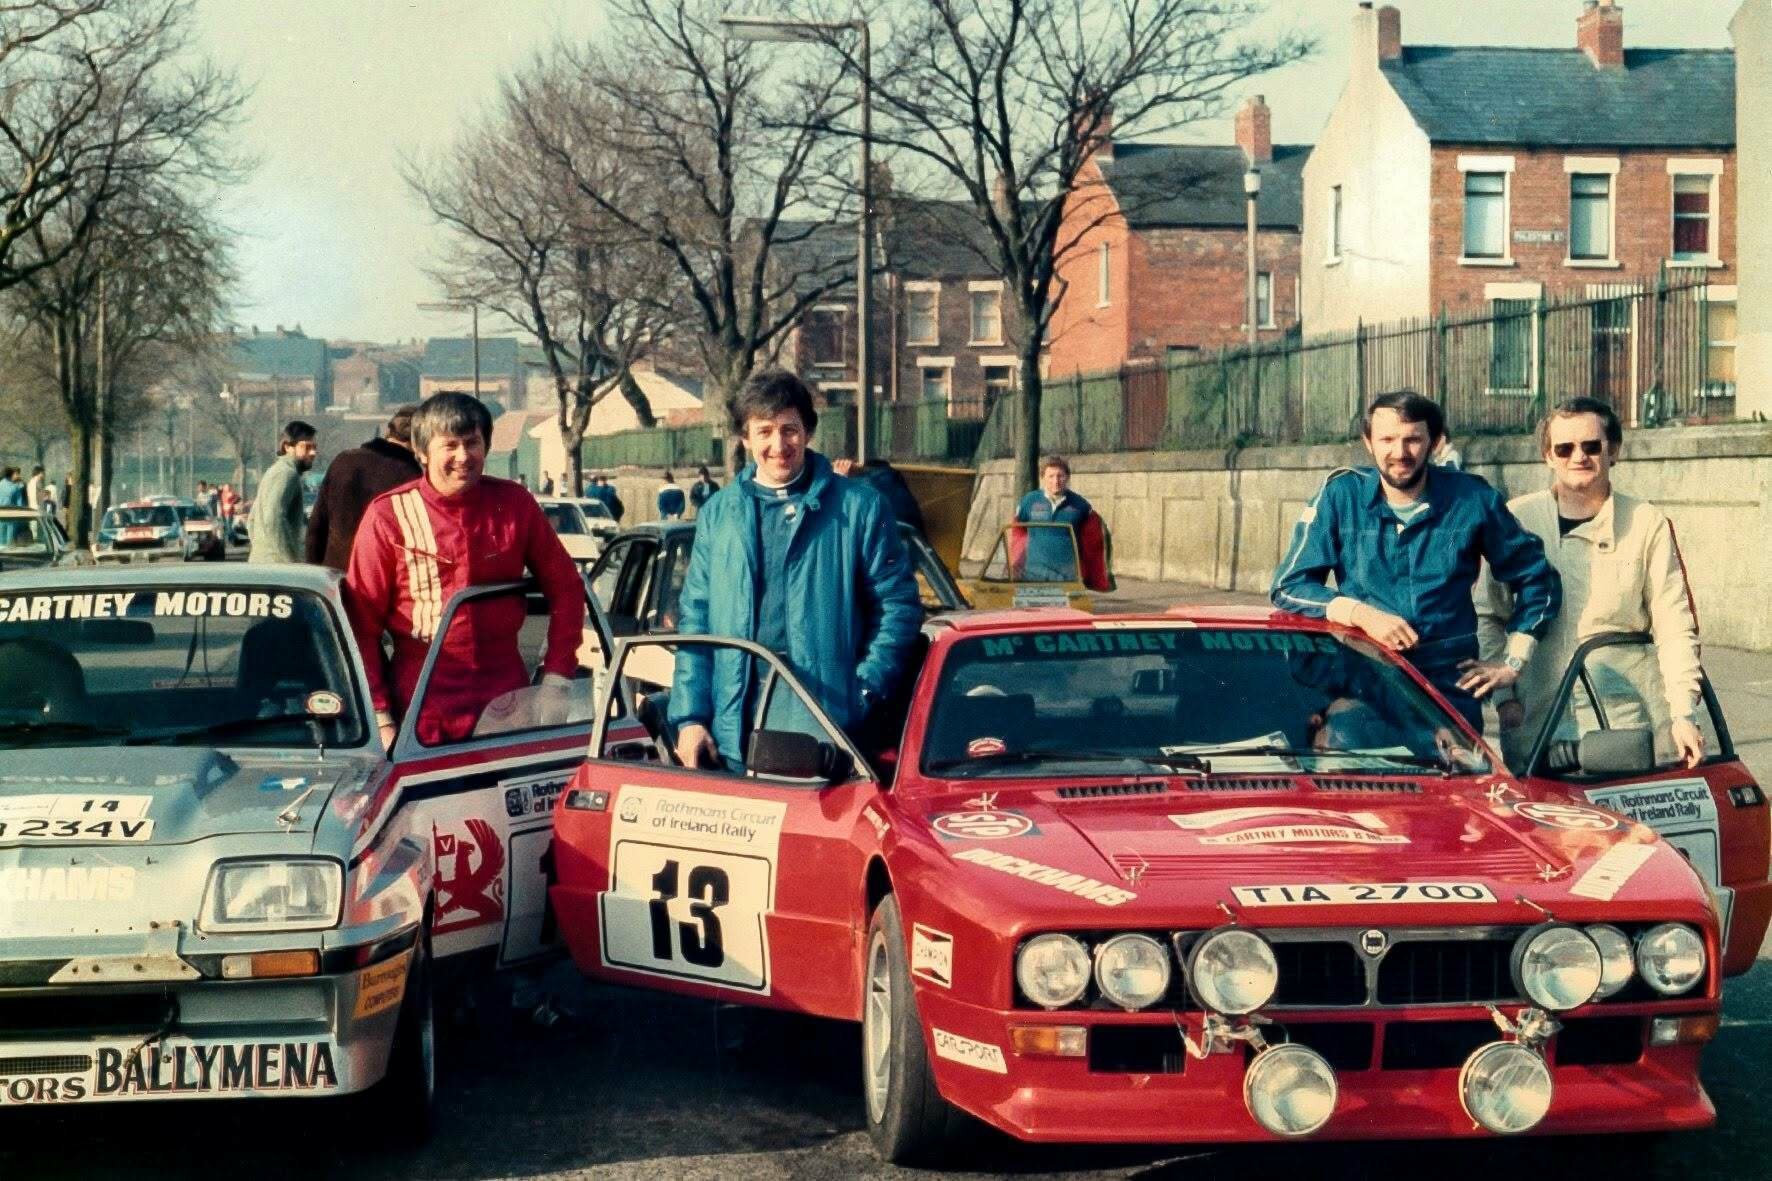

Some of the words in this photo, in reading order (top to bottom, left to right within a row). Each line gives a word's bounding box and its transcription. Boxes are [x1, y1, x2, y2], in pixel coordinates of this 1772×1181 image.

[154, 591, 293, 619] MOTORS
[1035, 632, 1176, 652] CARTNEY
[1201, 631, 1337, 654] MOTORS
[82, 799, 120, 812] 14
[1620, 791, 1674, 808] Rothmans
[1674, 787, 1710, 803] Circuit
[1638, 803, 1677, 821] Ireland
[1675, 799, 1702, 819] Rally
[655, 799, 728, 820] Rothmans
[730, 808, 777, 826] Circuit
[18, 819, 147, 838] 234V
[652, 815, 666, 828] of
[670, 819, 718, 835] Ireland
[721, 822, 757, 843] Rally
[951, 848, 1138, 906] DUCKHAMS
[1241, 886, 1331, 903] TIA
[1348, 885, 1484, 900] 2700
[649, 859, 729, 967] 13
[93, 1043, 338, 1096] BALLYMENA
